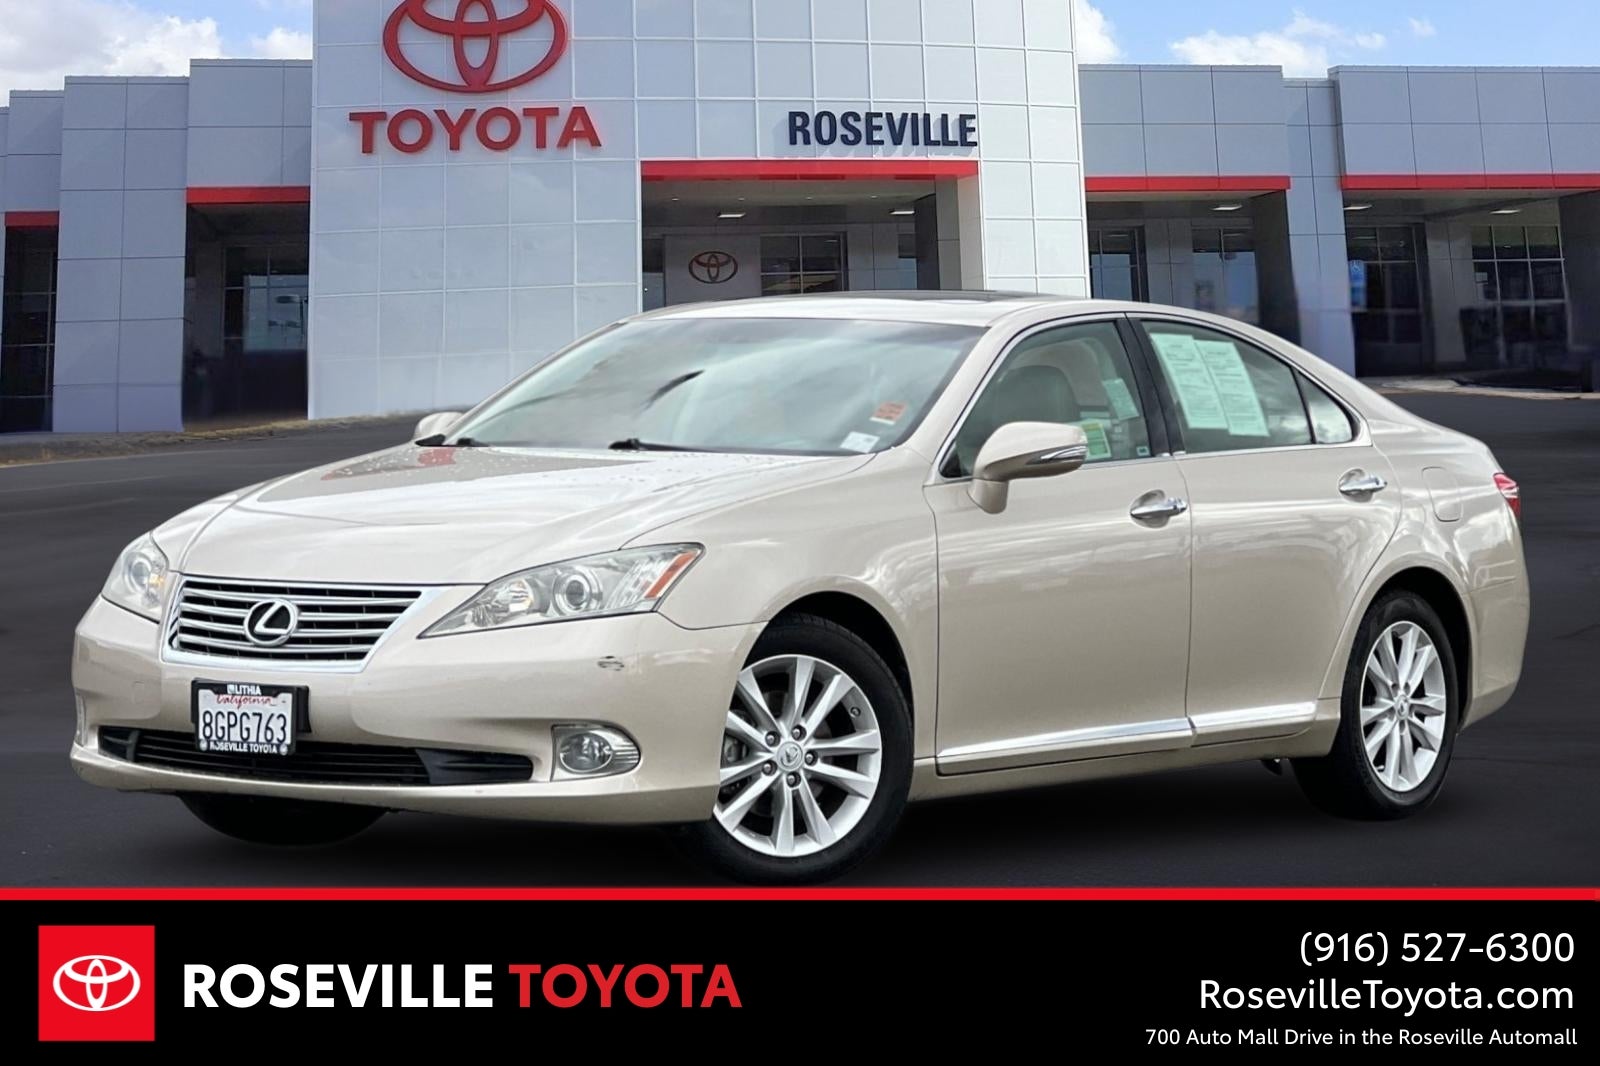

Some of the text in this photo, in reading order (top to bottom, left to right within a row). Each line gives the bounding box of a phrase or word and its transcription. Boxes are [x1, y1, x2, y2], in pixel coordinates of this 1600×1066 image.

[350, 106, 601, 153] TOYOTA
[788, 111, 978, 147] ROSEVILLE
[216, 694, 275, 709] California
[235, 685, 262, 696] LITHIA
[202, 710, 287, 744] 8GPG763
[209, 742, 278, 754] ROSEVILLE TOYOTA
